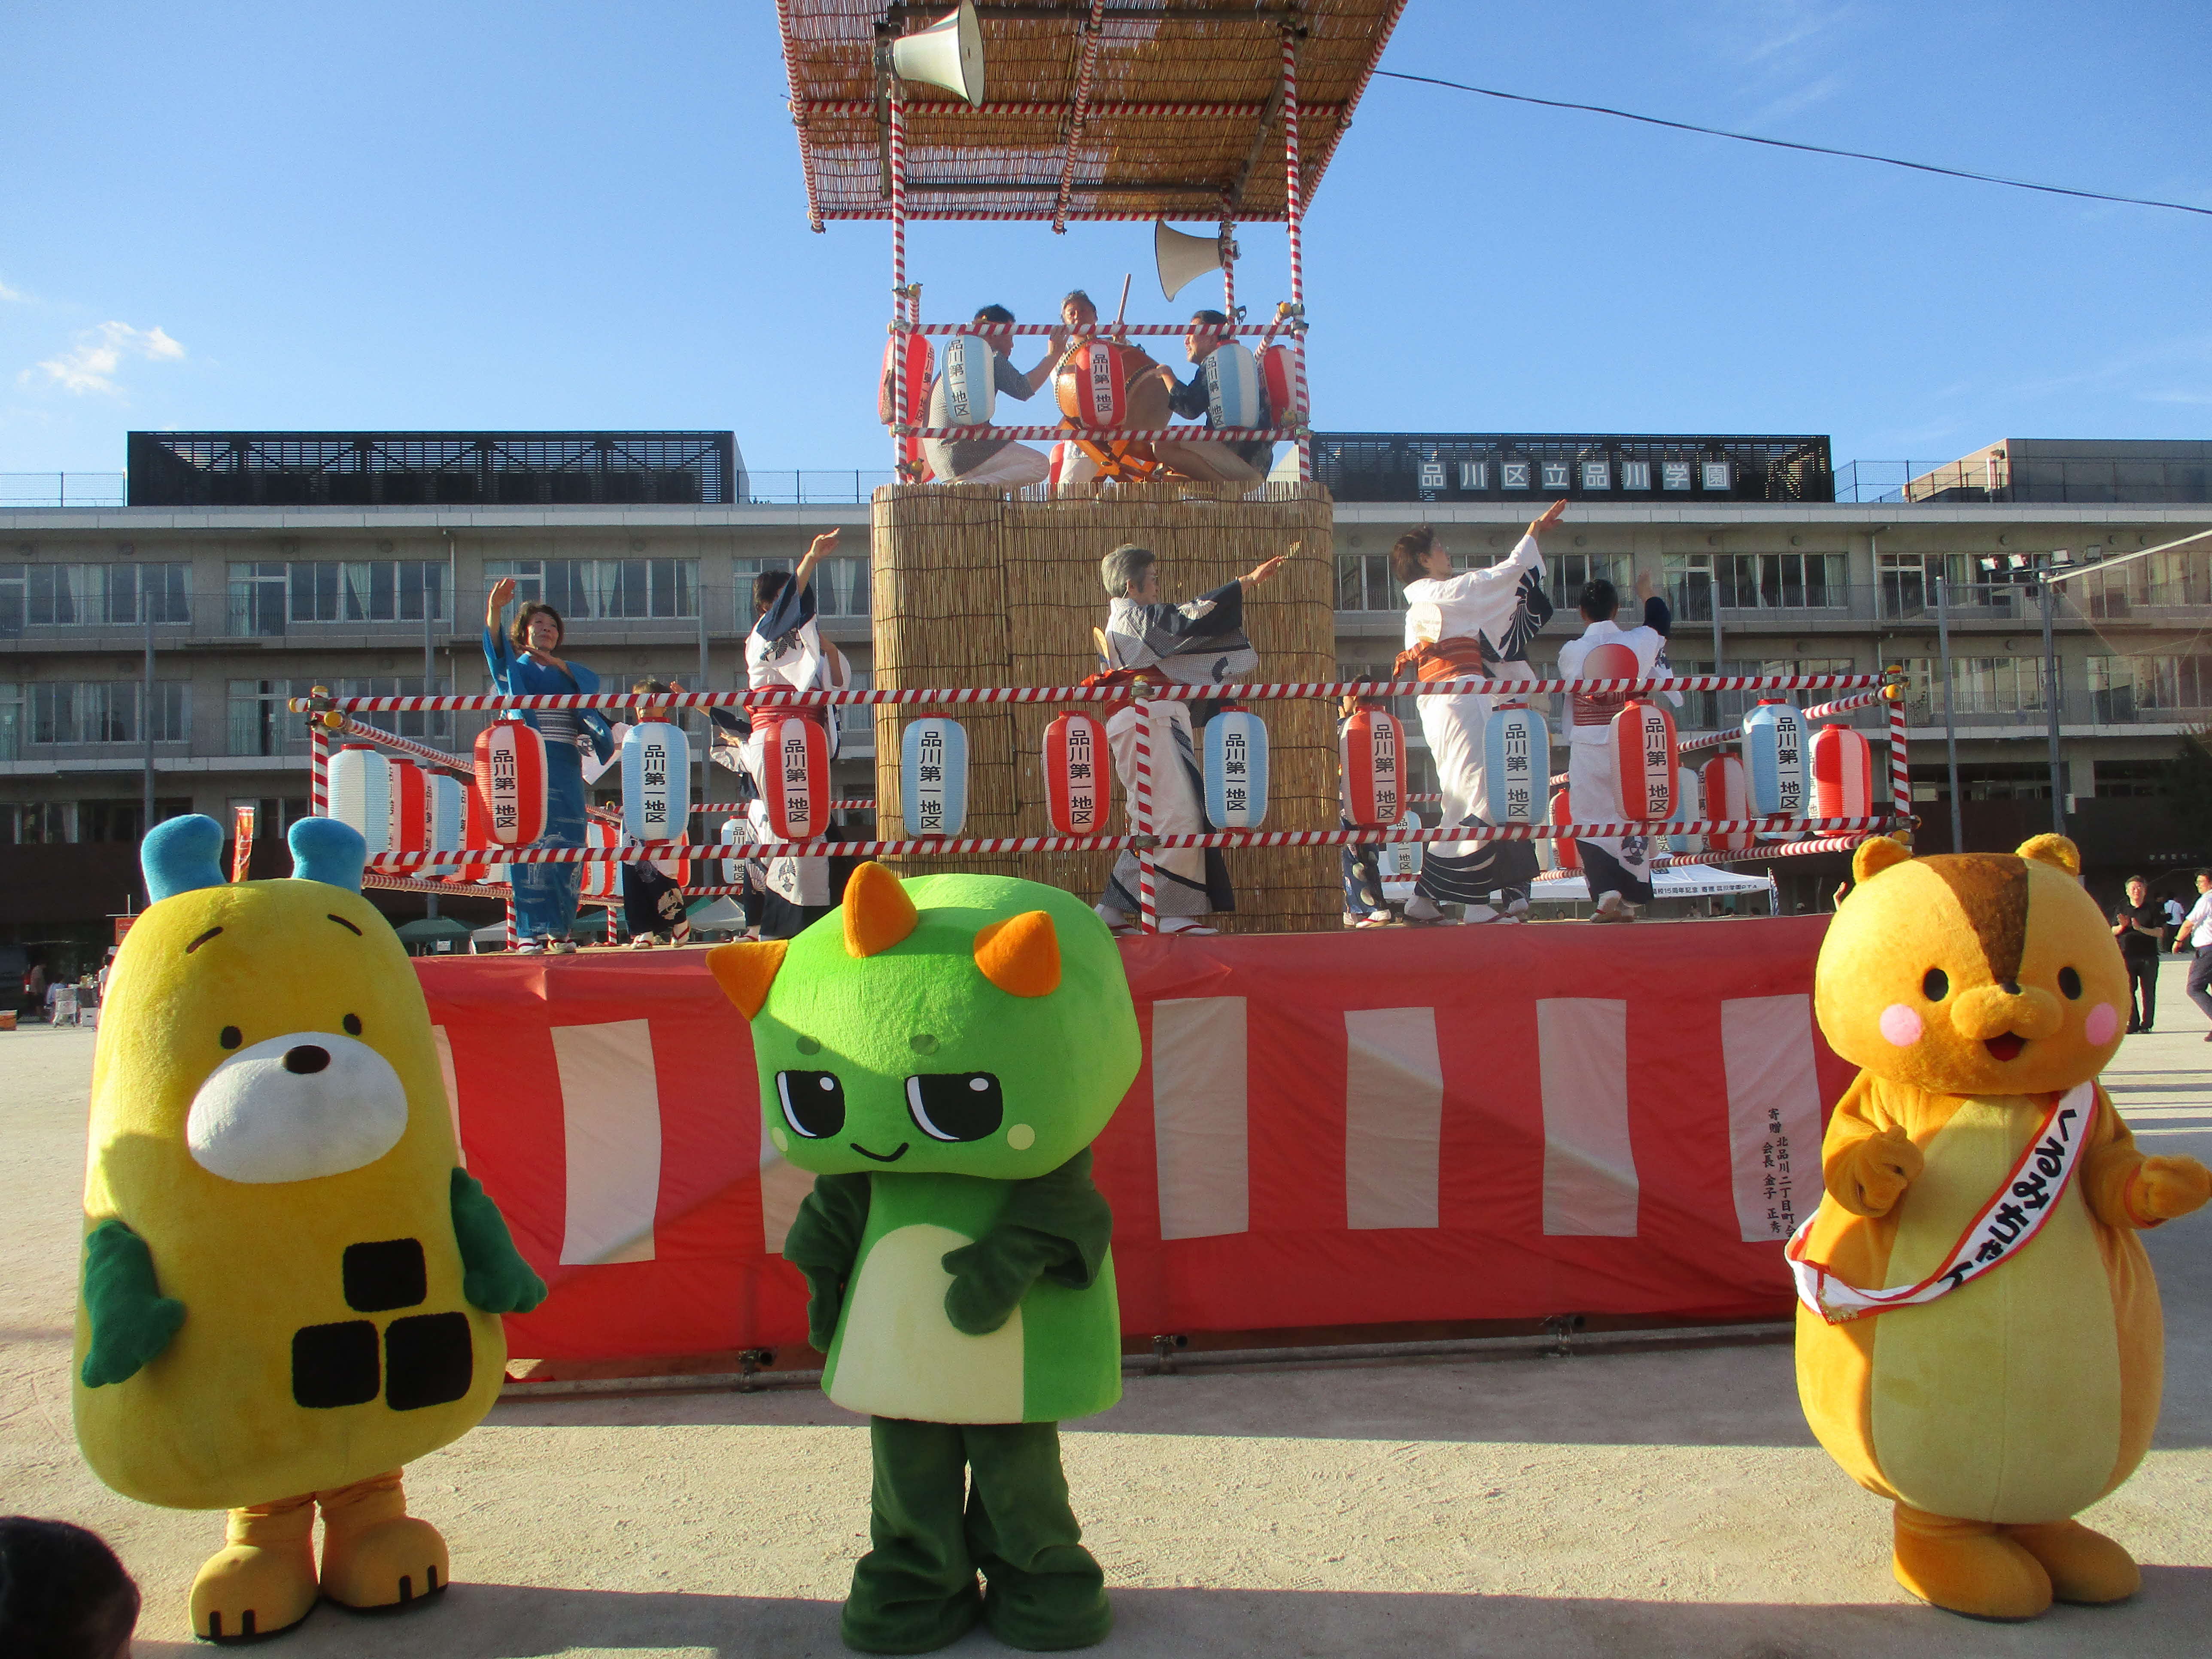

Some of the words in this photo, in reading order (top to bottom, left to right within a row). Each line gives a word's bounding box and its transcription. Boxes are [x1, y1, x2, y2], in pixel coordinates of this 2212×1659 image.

[948, 340, 970, 416] 品川第一地区
[1093, 354, 1112, 412] 品川第一地区
[1207, 356, 1224, 425] 品川第一地区
[1422, 464, 1727, 487] 品川区立品川学園
[493, 749, 517, 828] 品川第一地区
[644, 744, 666, 823] 品川第一地区
[784, 739, 809, 823] 品川第一地区
[920, 731, 942, 830] 品川第一地区
[1069, 730, 1093, 825] 品川第一地区
[1225, 733, 1247, 811] 品川第一地区
[1373, 724, 1396, 819] 品川第一地区
[1505, 724, 1529, 817] 品川第一地区
[1645, 718, 1668, 813] 品川第一地区
[1777, 717, 1801, 809] 品川第一地区
[733, 827, 744, 881] 品川一地区
[1762, 1142, 1774, 1168] 会長
[1768, 1108, 1781, 1133] 寄贈
[1763, 1173, 1777, 1200] 金子
[1777, 1136, 1796, 1237] 北品川二丁目町会
[1937, 1109, 2077, 1289] くるみちゃん
